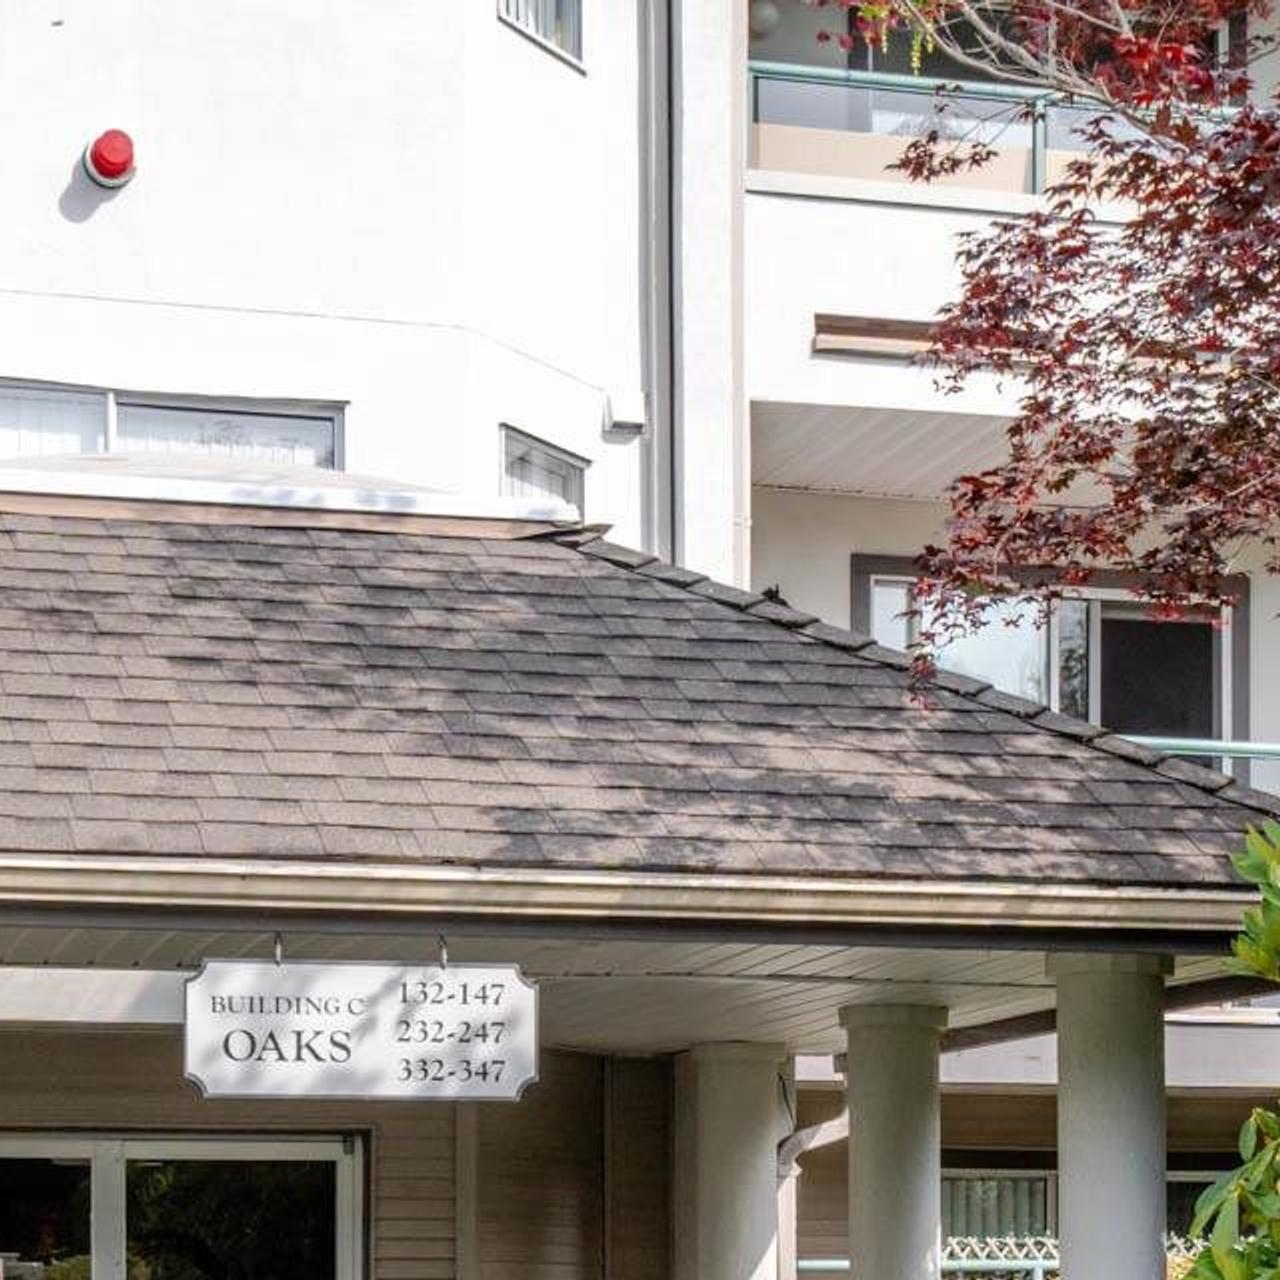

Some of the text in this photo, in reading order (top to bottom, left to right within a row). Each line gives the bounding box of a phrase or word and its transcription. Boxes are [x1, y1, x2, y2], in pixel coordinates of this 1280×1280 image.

[211, 995, 366, 1017] BUILDING C
[400, 981, 505, 1006] 132-147
[396, 1020, 506, 1044] 232-247
[222, 1028, 352, 1063] OAKS
[398, 1058, 506, 1083] 332-347
